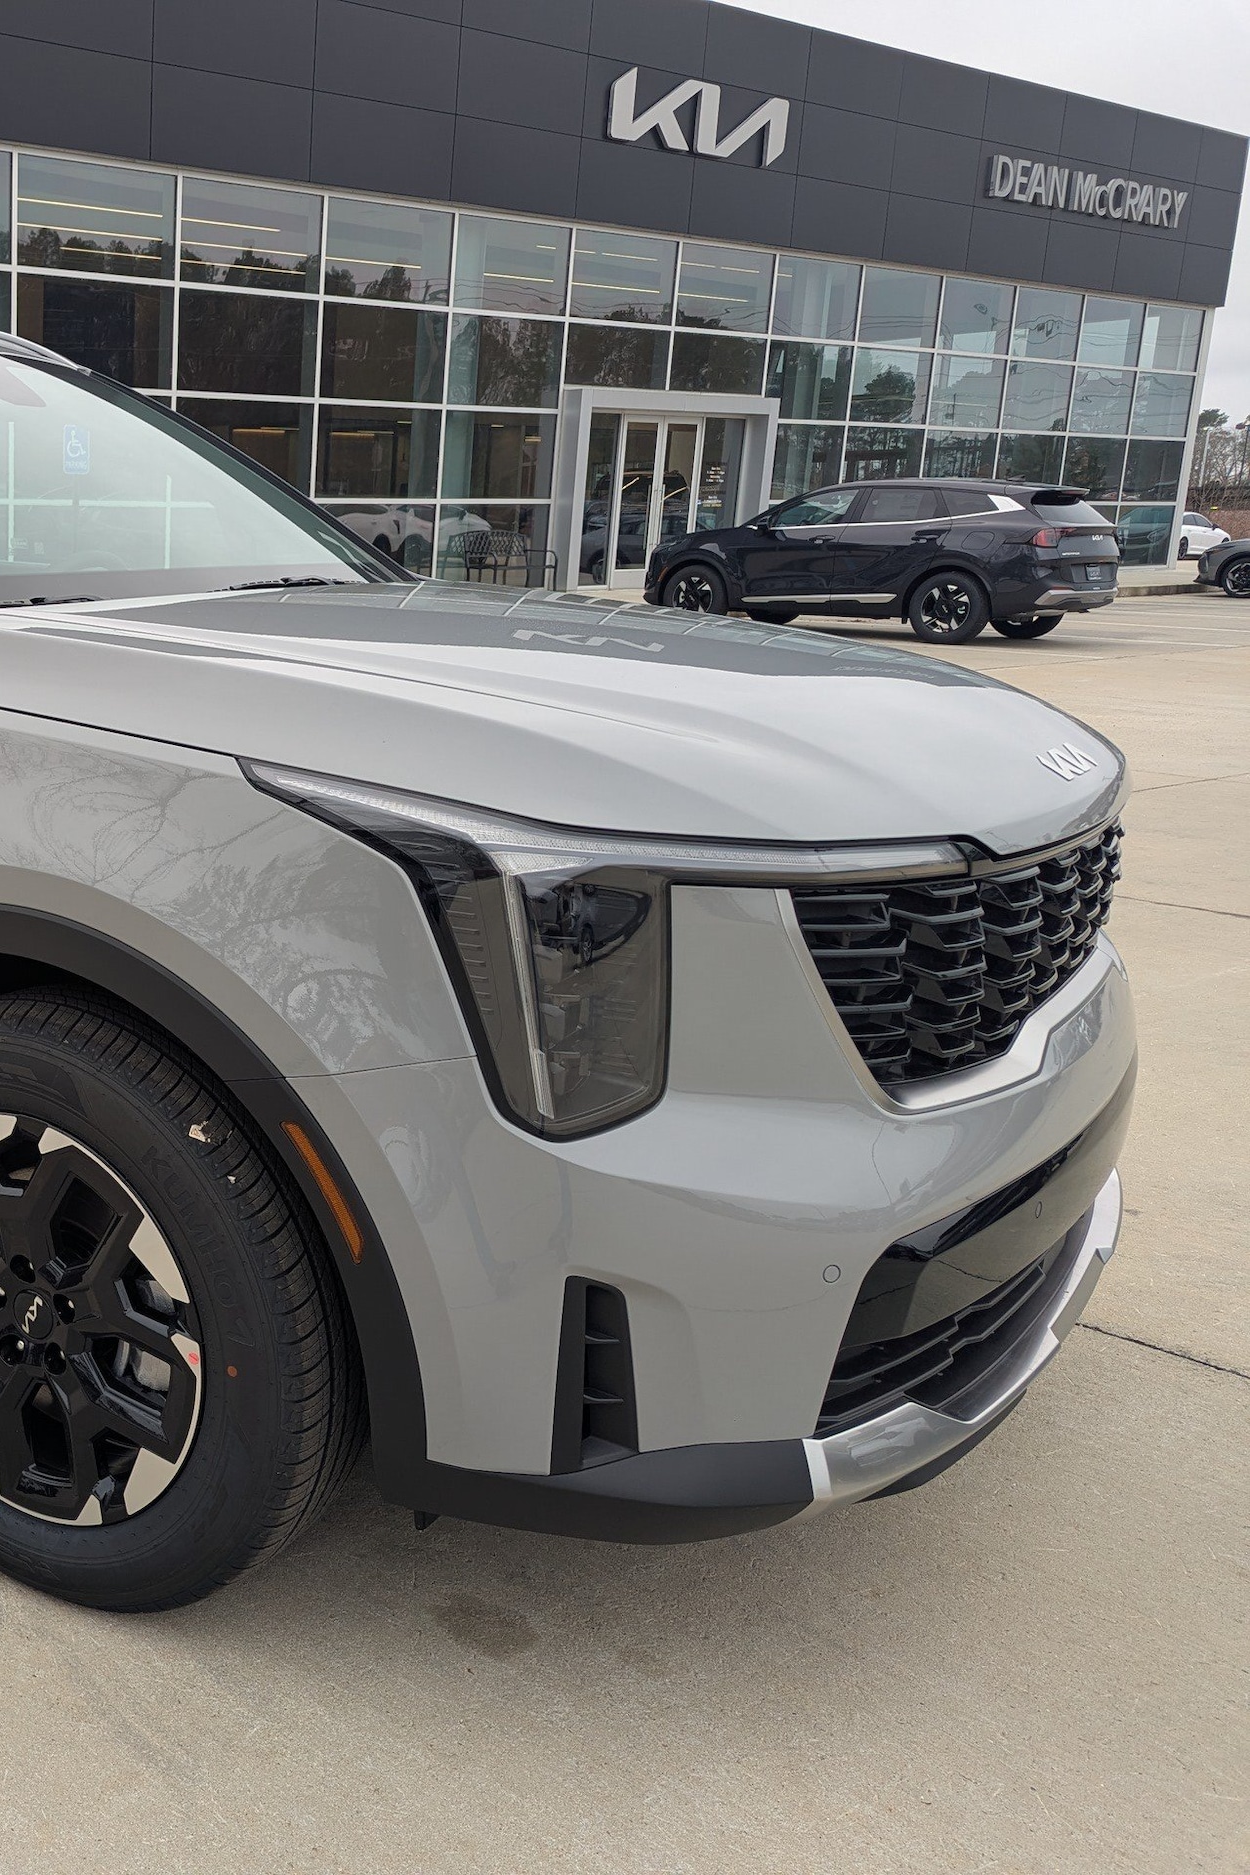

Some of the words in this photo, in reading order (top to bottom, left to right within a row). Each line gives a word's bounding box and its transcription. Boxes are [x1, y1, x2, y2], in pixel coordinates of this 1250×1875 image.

[607, 67, 790, 167] KIA
[989, 155, 1069, 208] DEAN
[1069, 171, 1188, 228] McCRARY
[1036, 742, 1097, 781] KIA
[141, 1146, 237, 1308] KUMHO
[22, 1296, 43, 1333] KIA
